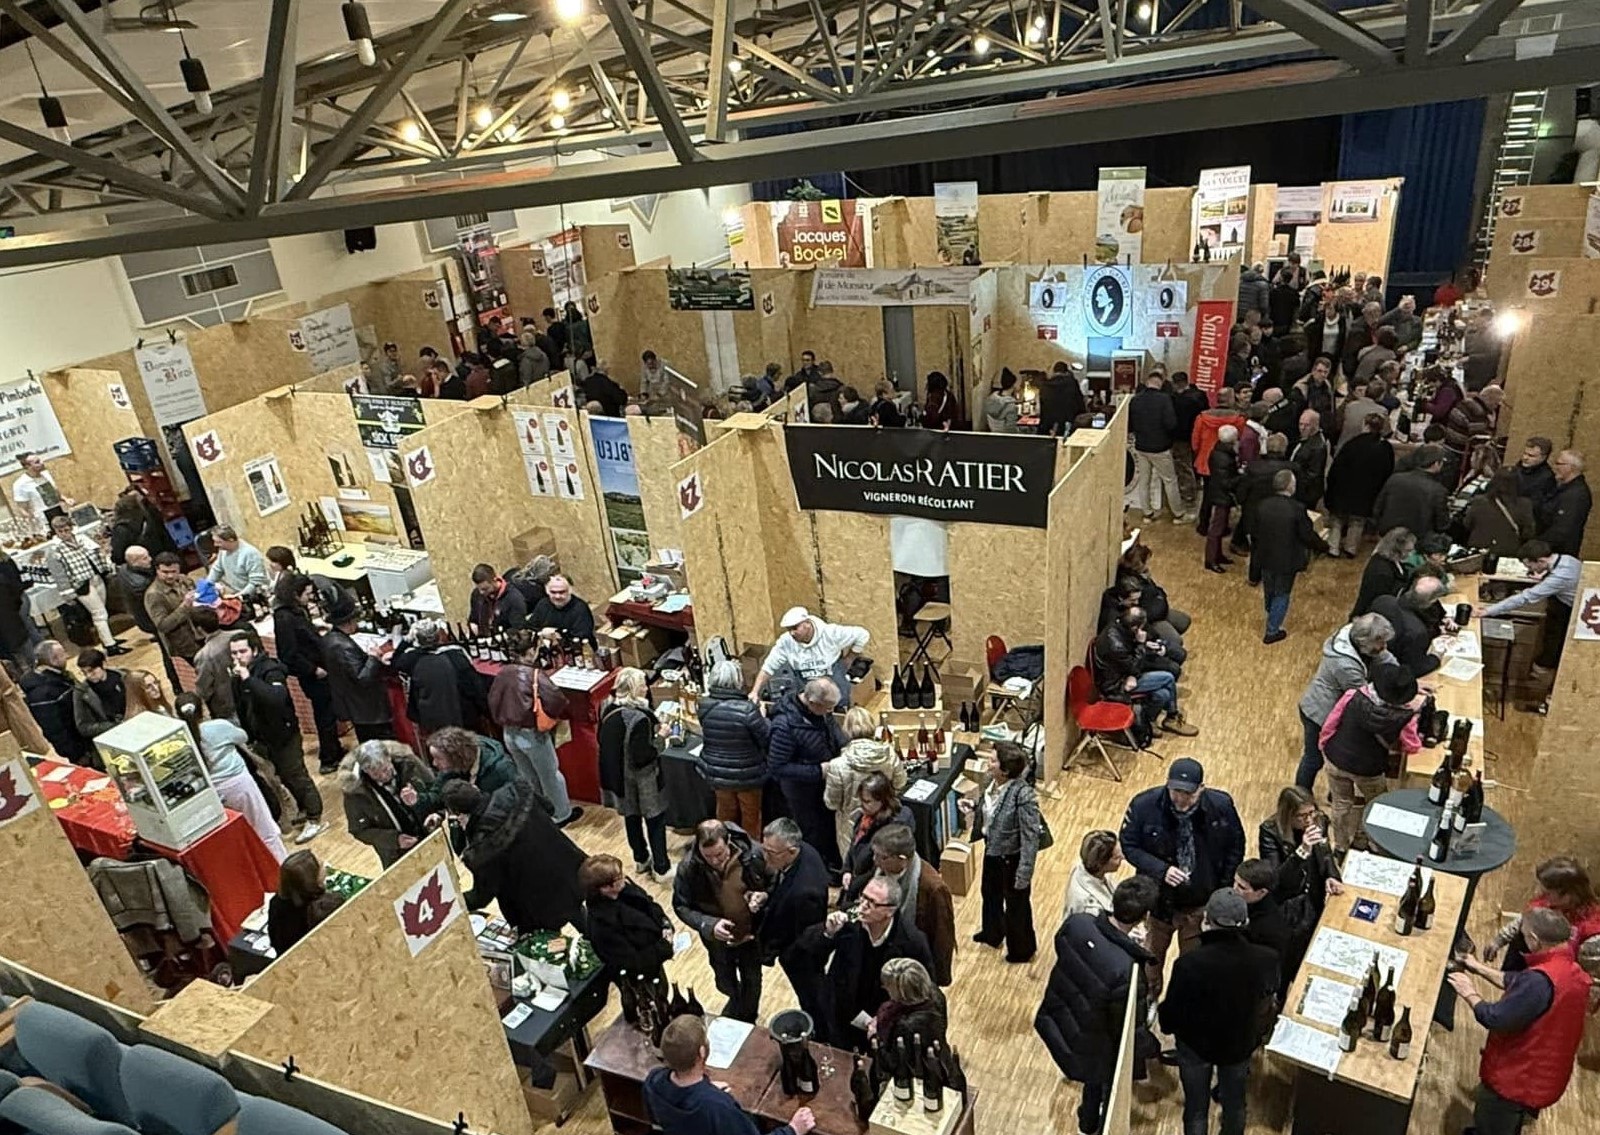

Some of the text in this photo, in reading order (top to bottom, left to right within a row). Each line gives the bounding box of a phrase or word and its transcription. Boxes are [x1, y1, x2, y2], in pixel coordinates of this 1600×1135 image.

[792, 229, 846, 246] Jacques
[1515, 236, 1531, 248] 28
[793, 244, 848, 262] Bockel
[1532, 278, 1551, 291] 29
[202, 442, 213, 456] 5
[414, 460, 424, 474] 6
[863, 490, 976, 510] VIGNERON RÉCOLTANT
[418, 898, 435, 924] 4
